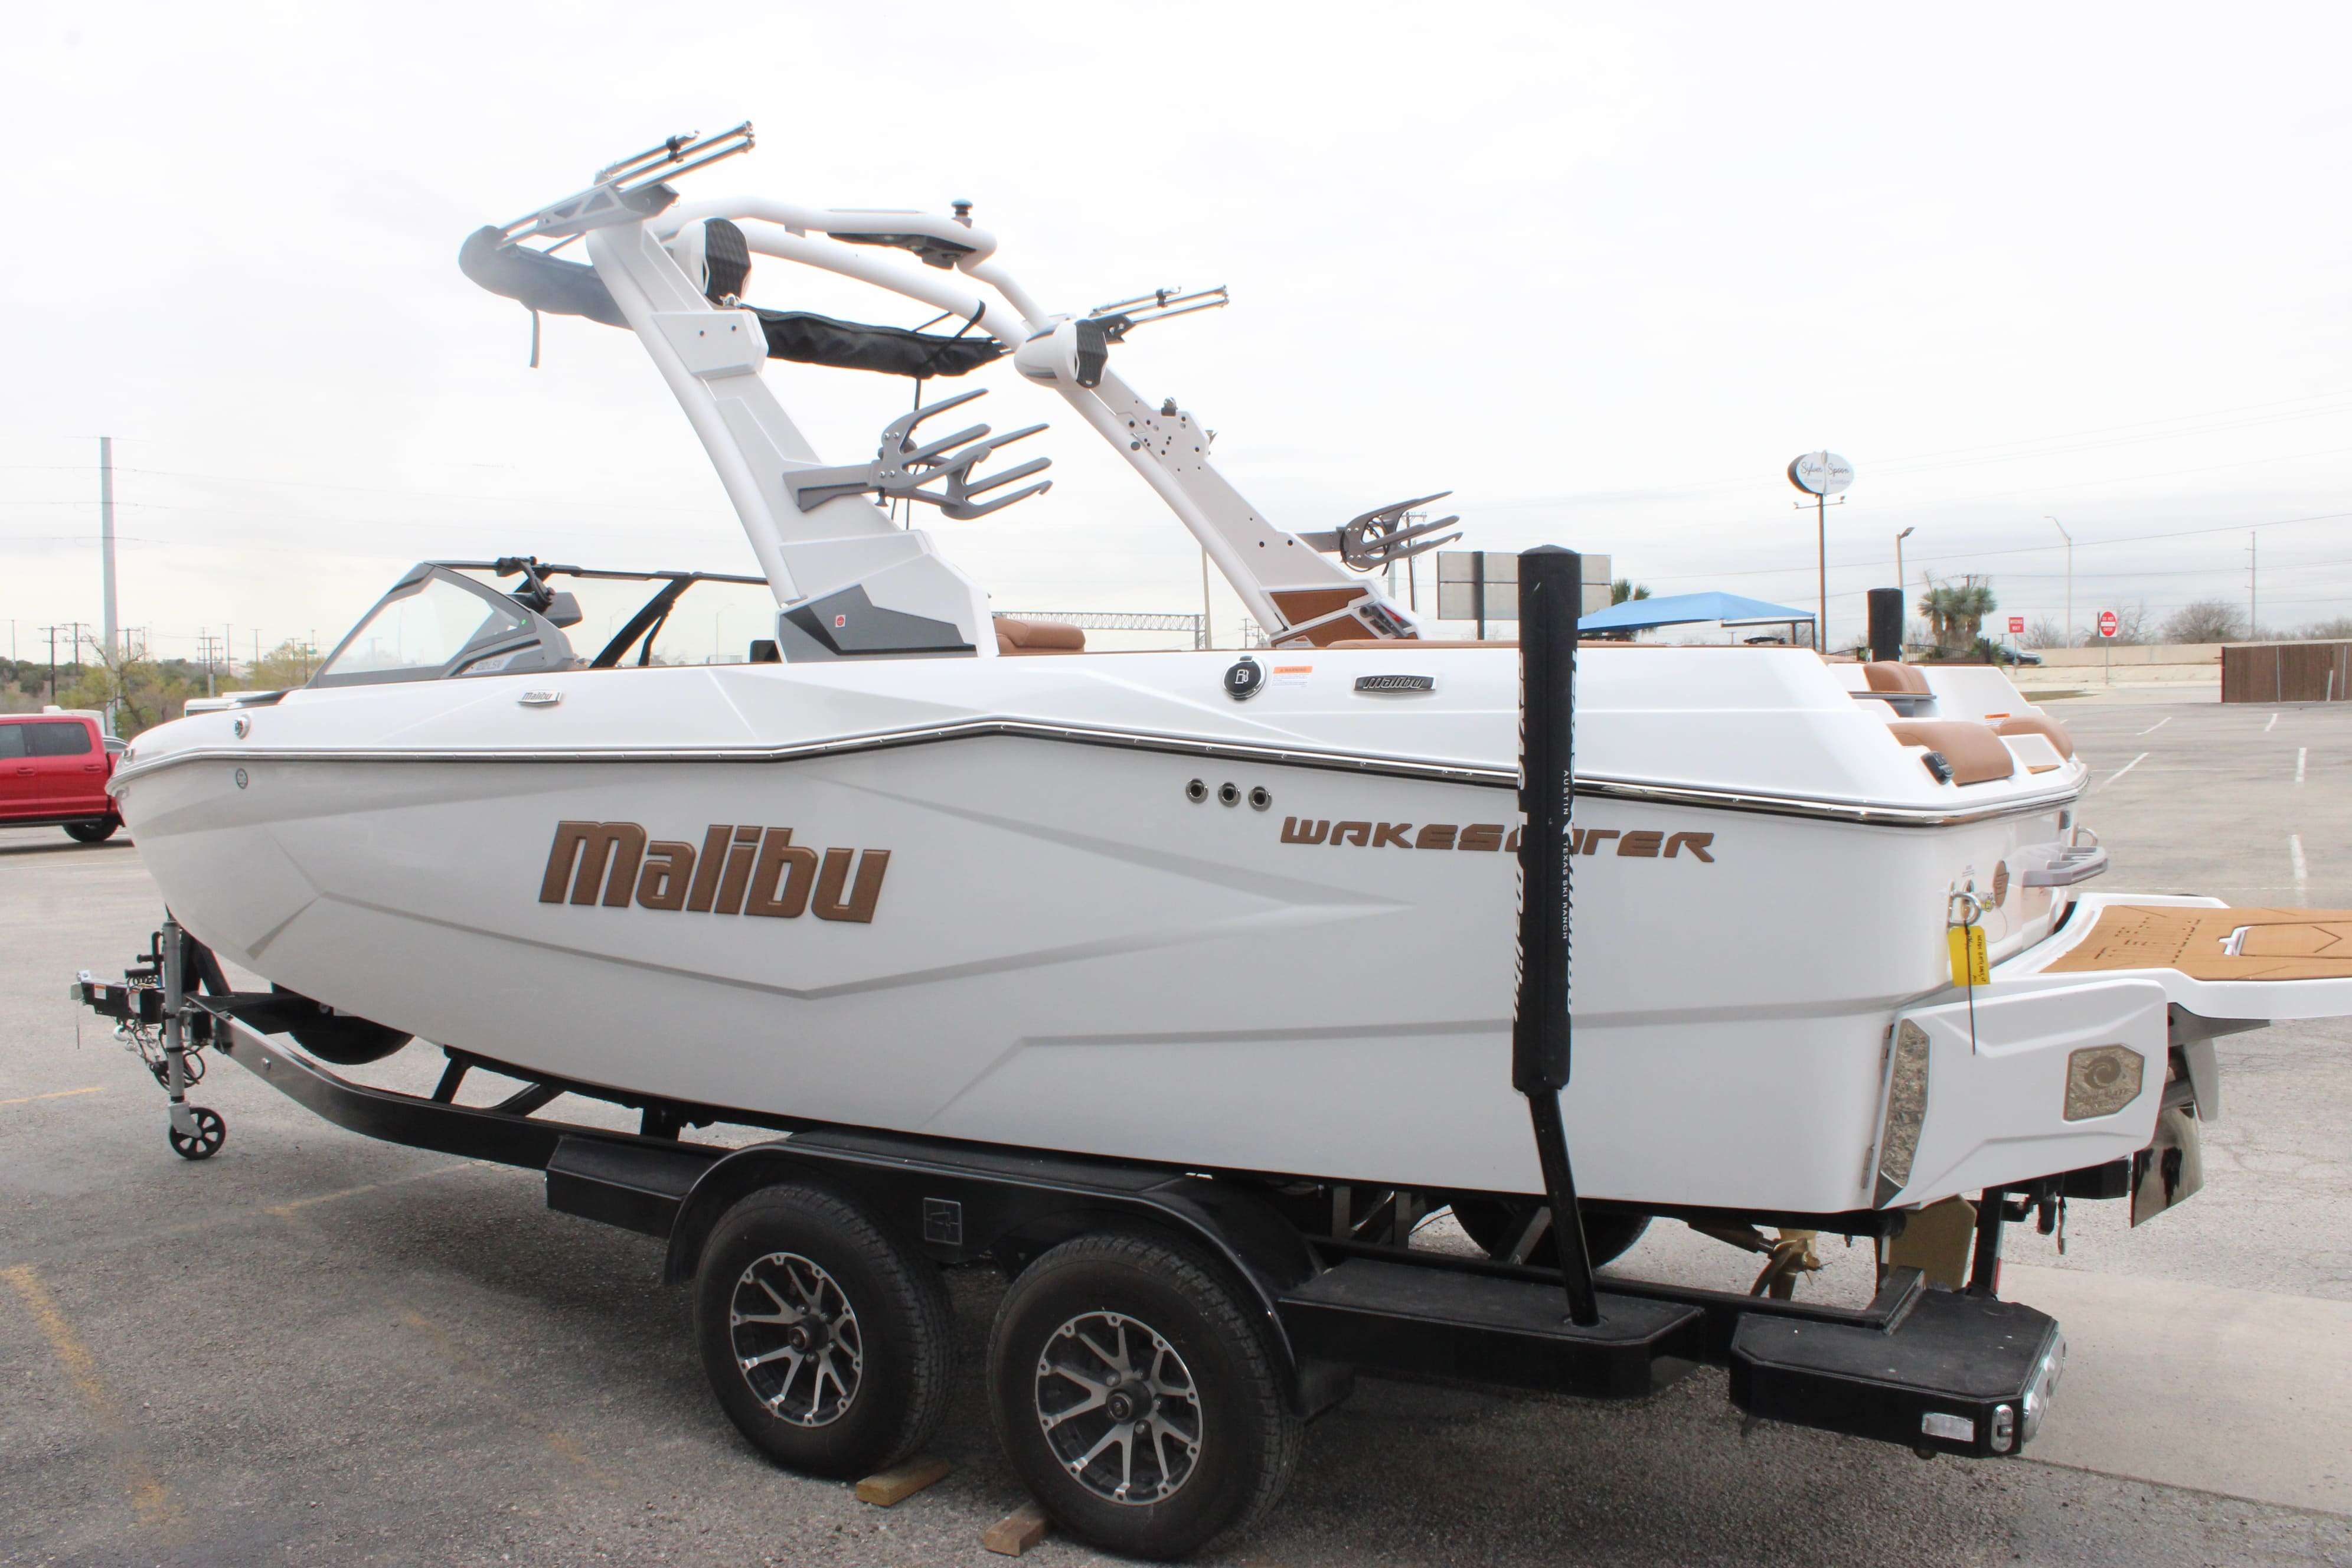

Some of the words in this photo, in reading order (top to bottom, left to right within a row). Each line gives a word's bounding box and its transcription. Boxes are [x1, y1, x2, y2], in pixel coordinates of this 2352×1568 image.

[522, 692, 553, 701] Malibu
[1363, 677, 1424, 689] Malibu
[1280, 816, 1715, 863] WAKESTER
[538, 821, 891, 924] Malibu
